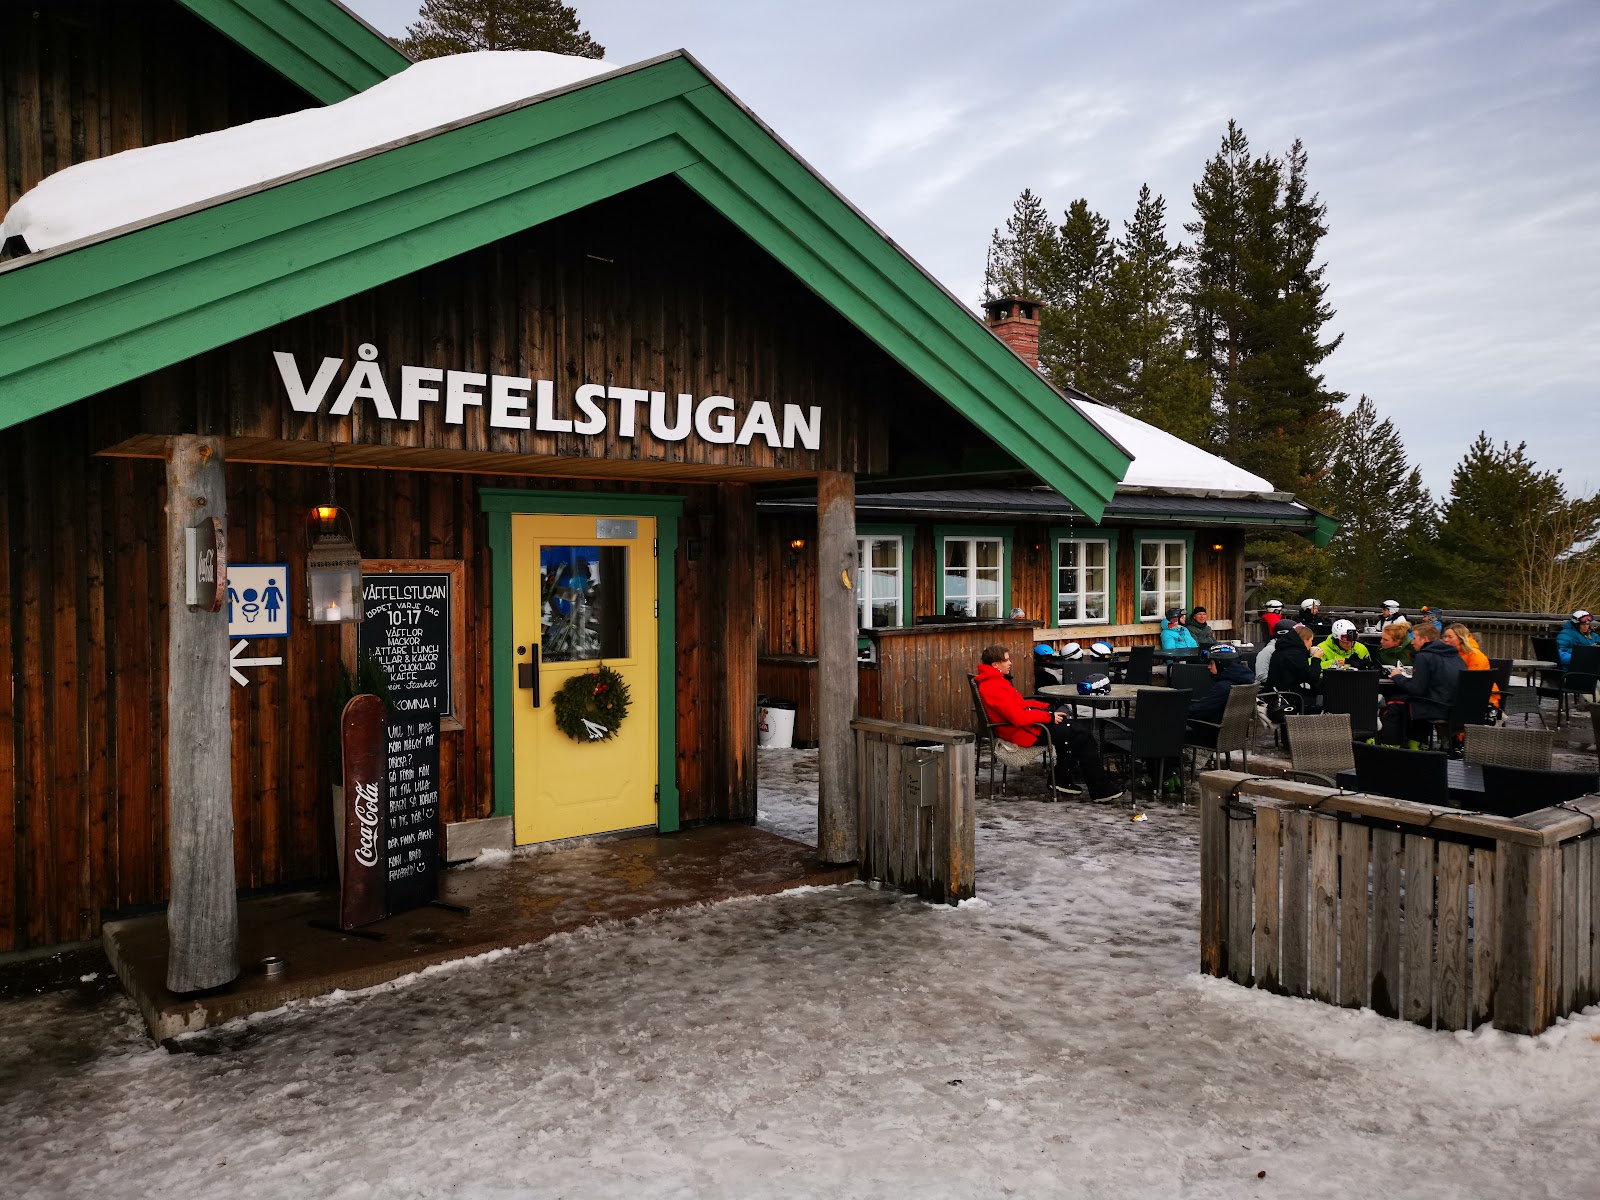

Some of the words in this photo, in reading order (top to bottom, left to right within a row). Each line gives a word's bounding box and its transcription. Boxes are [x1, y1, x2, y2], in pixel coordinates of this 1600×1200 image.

[273, 342, 821, 450] VÅFFELSTUGAN
[362, 583, 446, 600] VÅFFELSTUGAN
[366, 602, 392, 619] ÖPPET
[424, 605, 440, 617] DAG
[387, 609, 421, 626] 10-17
[385, 626, 424, 638] VÅFFLOR
[387, 637, 421, 646] MACKOR
[412, 645, 439, 655] LUNCH
[405, 655, 411, 663] &
[412, 654, 439, 662] KAKOR
[399, 662, 436, 672] CHOKLAD
[391, 672, 417, 681] KAFFE
[355, 781, 379, 867] Coca-Cola
